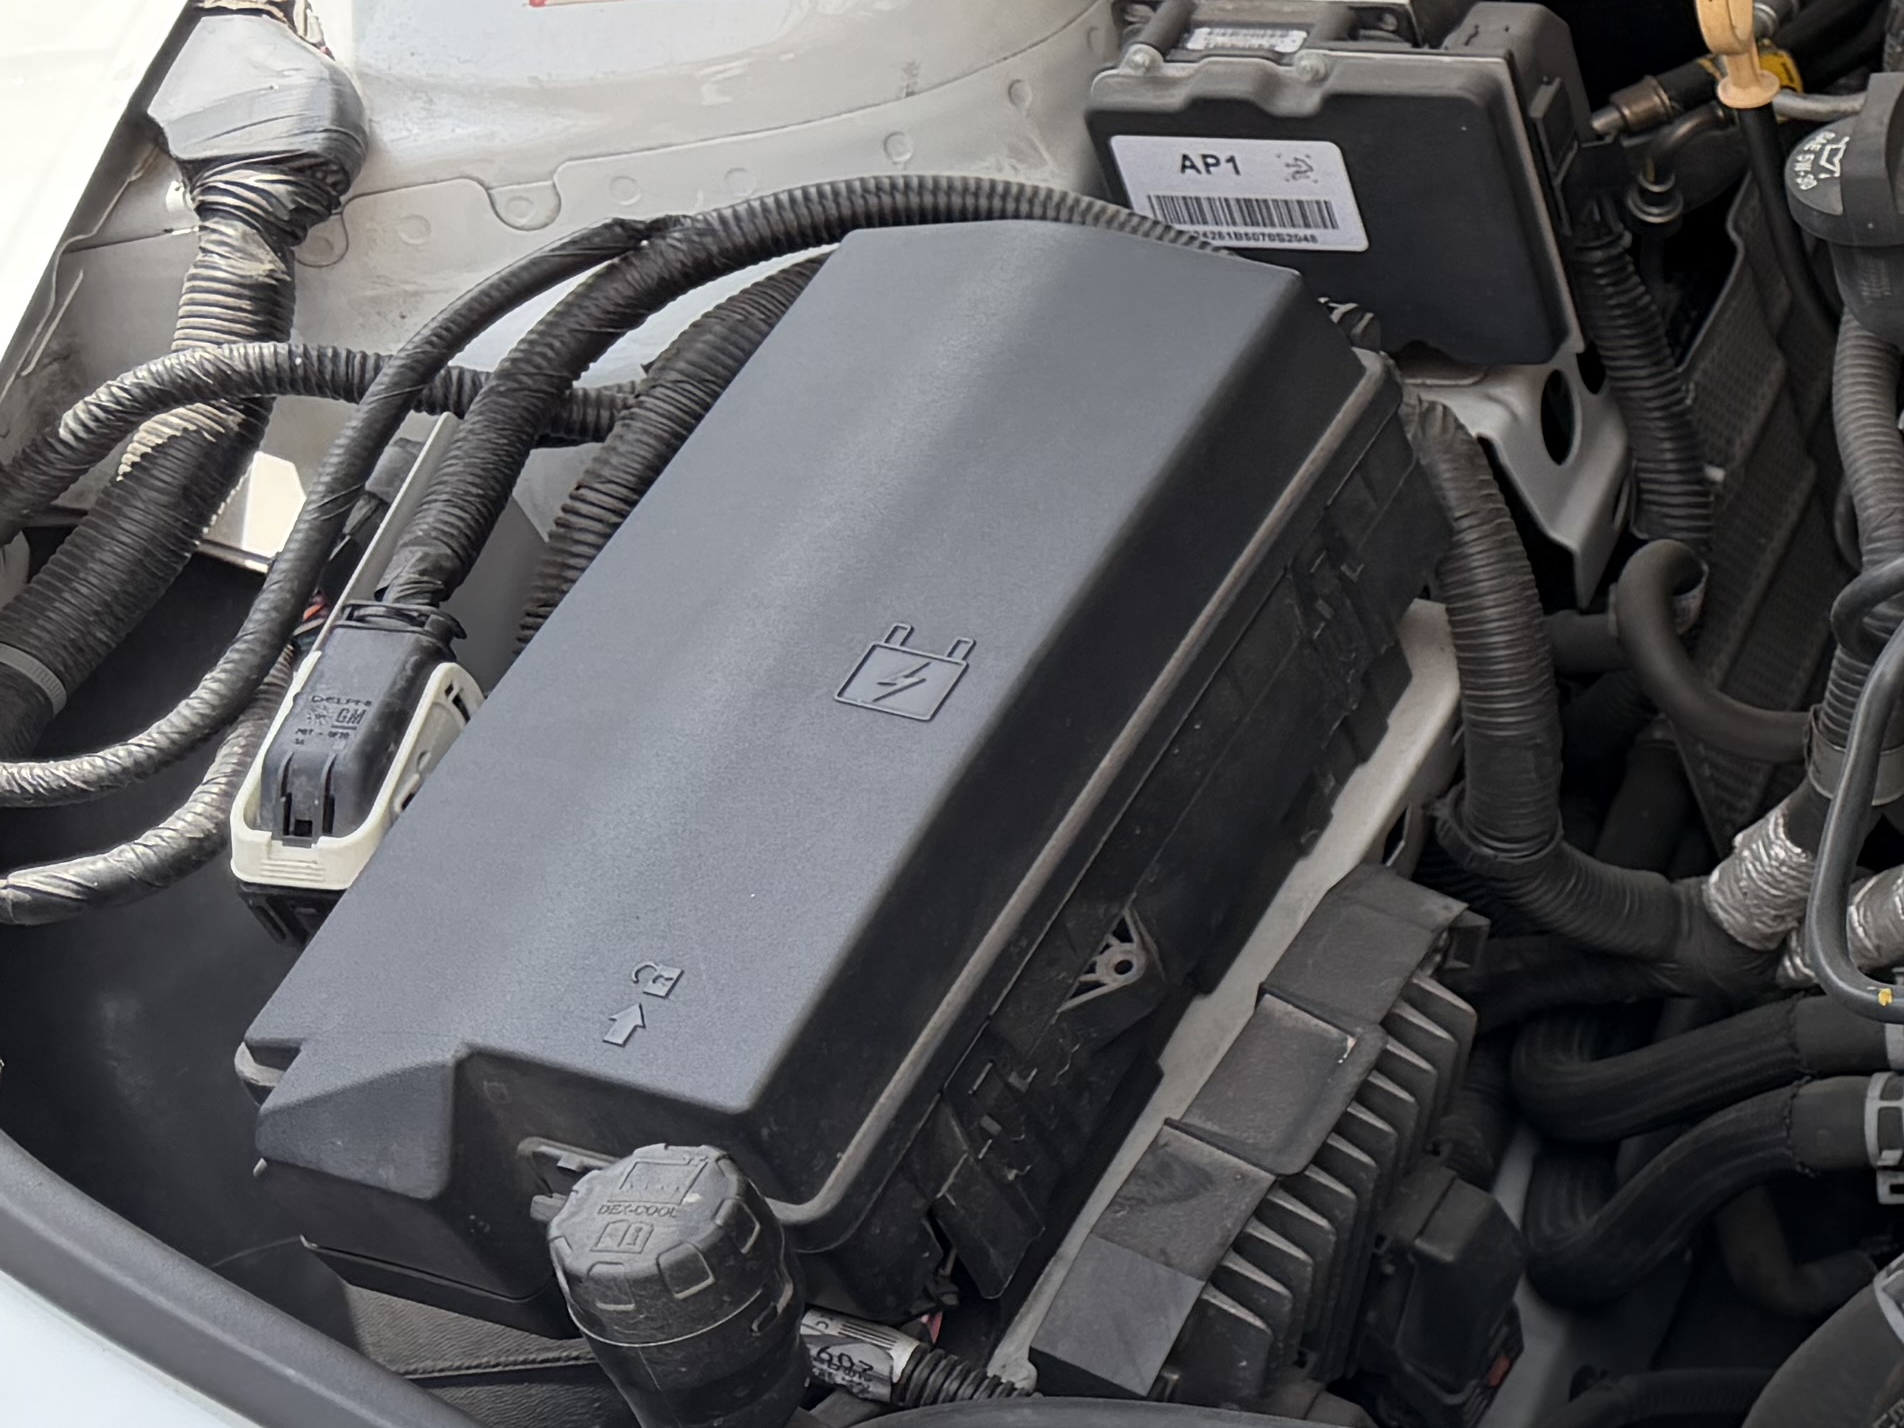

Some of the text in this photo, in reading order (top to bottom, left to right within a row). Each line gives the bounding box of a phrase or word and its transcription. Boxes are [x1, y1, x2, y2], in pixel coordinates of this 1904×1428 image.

[1179, 153, 1241, 176] AP1
[336, 708, 367, 724] GM
[598, 1204, 678, 1219] DEX-COOL
